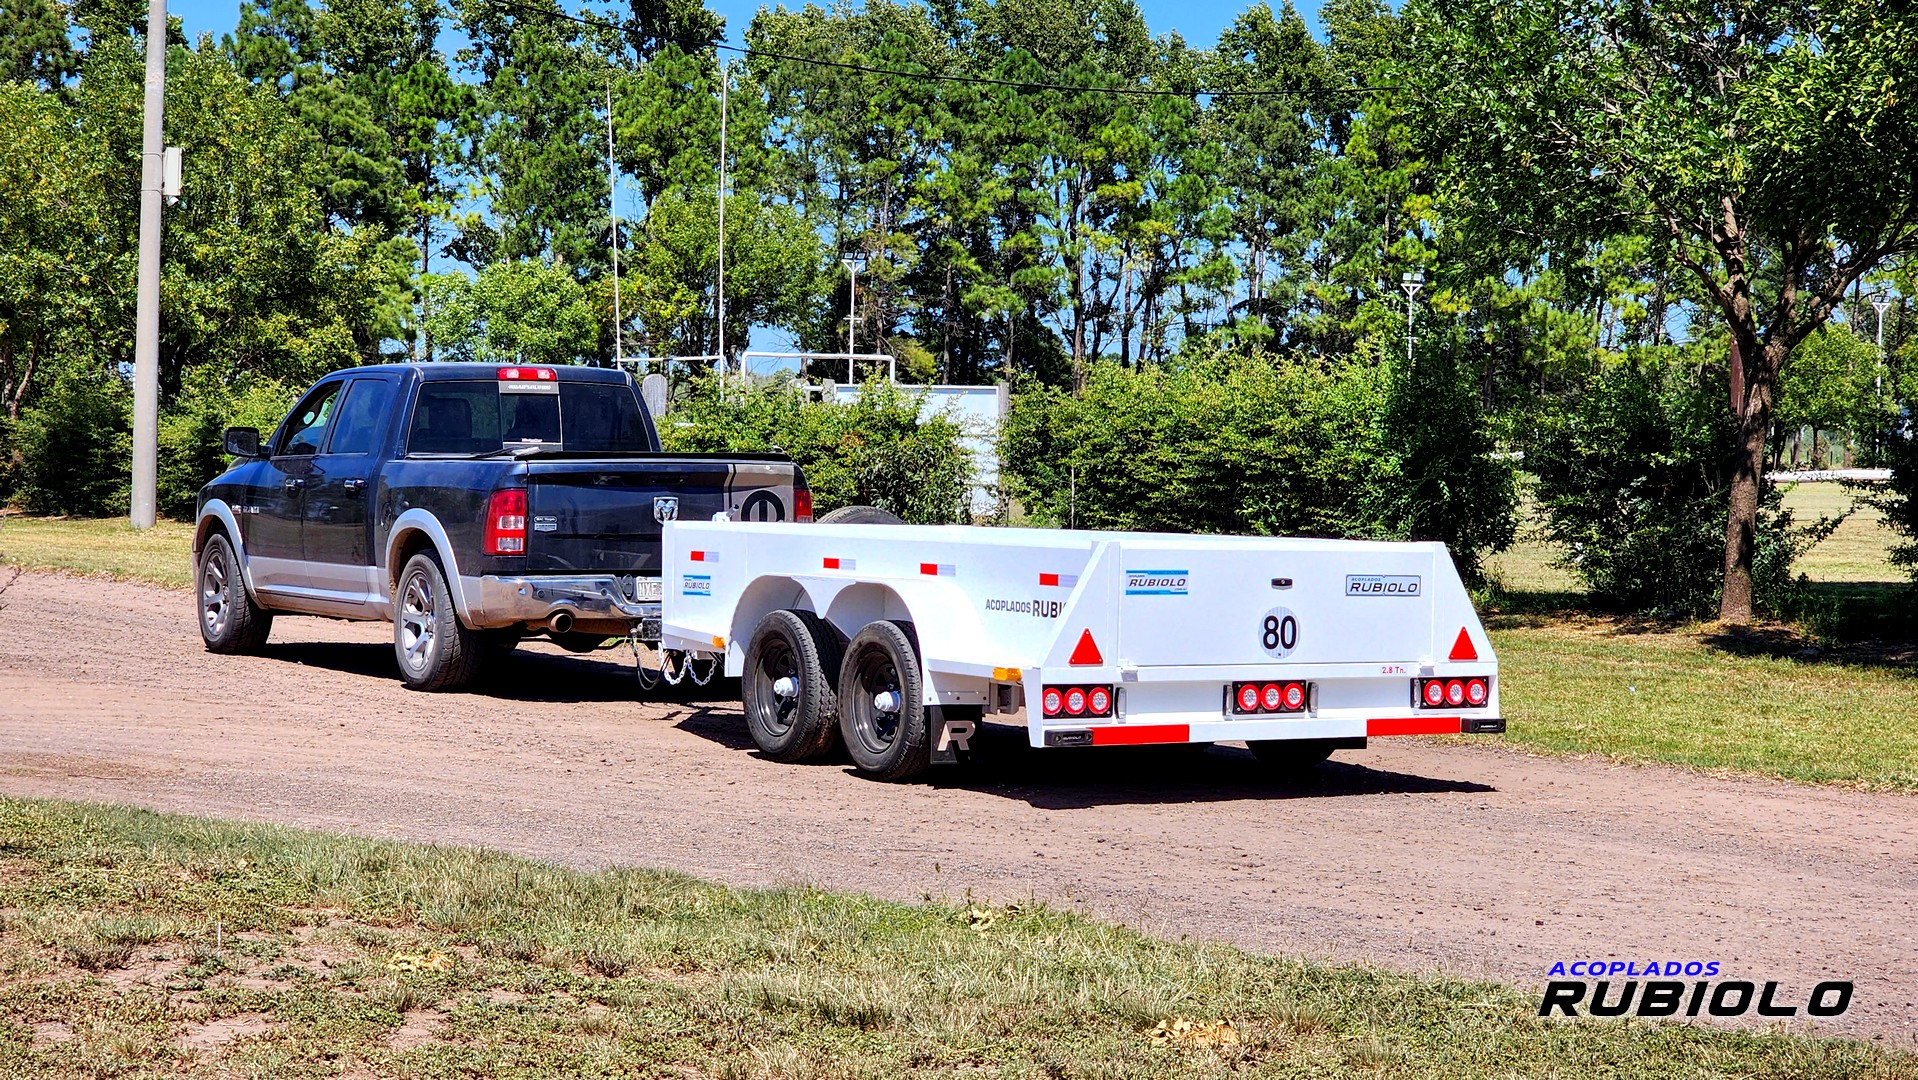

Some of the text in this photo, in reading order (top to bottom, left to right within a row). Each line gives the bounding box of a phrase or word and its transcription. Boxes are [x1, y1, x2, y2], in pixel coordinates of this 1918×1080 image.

[684, 581, 710, 590] RUBIOLO
[1129, 578, 1186, 587] RUBIOLO
[1350, 582, 1418, 593] RUBIOLO
[985, 599, 1067, 618] ACOPLADOS RUBI
[1263, 615, 1297, 650] 80
[1382, 666, 1407, 674] 2.8 Tn.
[937, 720, 976, 751] R
